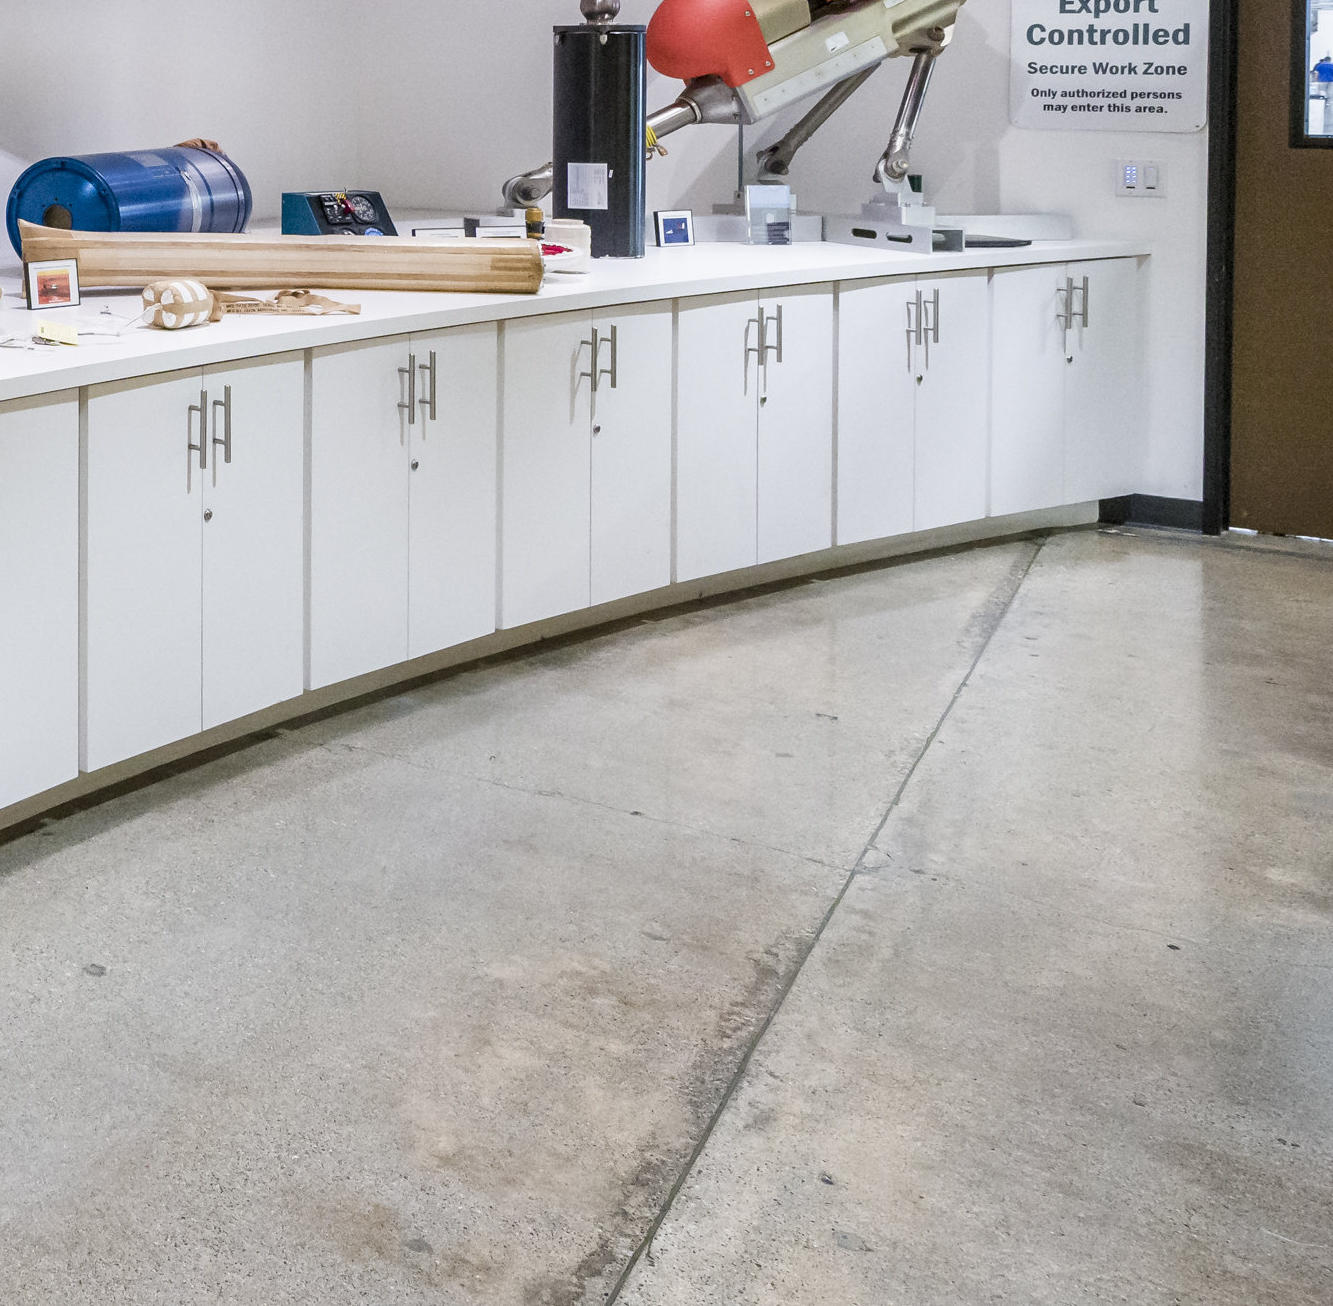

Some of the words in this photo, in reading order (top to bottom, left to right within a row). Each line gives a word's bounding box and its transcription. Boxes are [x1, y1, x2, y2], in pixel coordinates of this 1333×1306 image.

[1026, 22, 1190, 46] Controlled
[1027, 61, 1088, 75] Secure
[1092, 62, 1138, 75] Work
[1142, 62, 1188, 75] Zone
[1031, 88, 1058, 100] Only
[1060, 88, 1127, 99] authorized
[1130, 90, 1182, 102] persons
[1043, 103, 1068, 114] may
[1071, 103, 1104, 113] enter
[1108, 102, 1131, 113] this
[1135, 103, 1168, 113] area.
